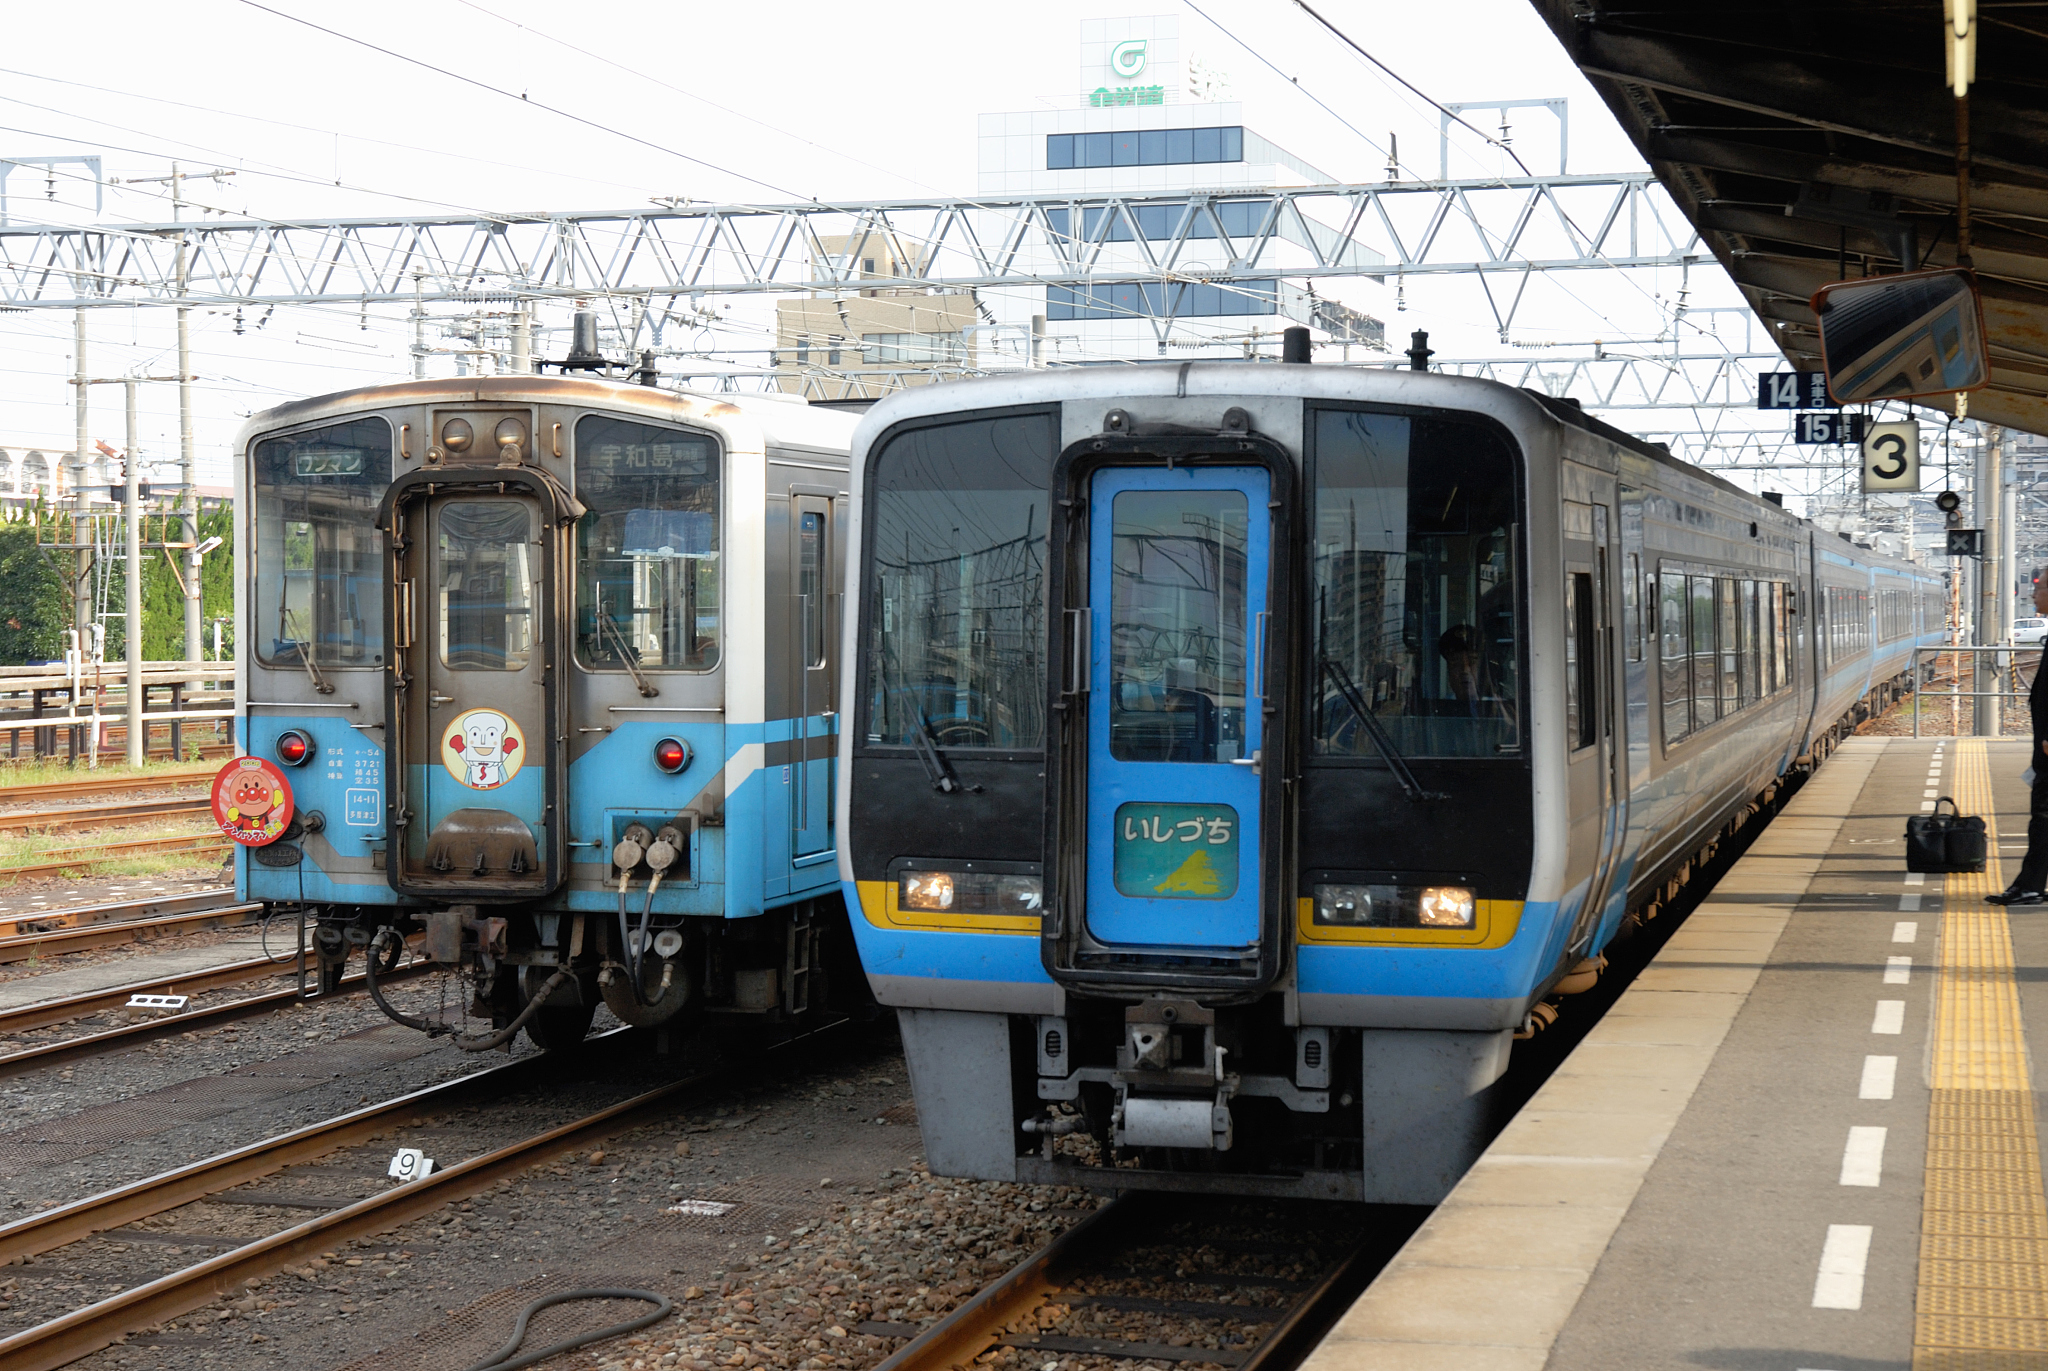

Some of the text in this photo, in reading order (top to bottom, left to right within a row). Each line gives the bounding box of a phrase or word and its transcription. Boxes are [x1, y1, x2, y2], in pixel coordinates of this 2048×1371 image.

[1768, 374, 1800, 408] 14
[1810, 373, 1826, 408] 乗車口
[1802, 415, 1831, 442] 15
[298, 454, 361, 472] ワンマン
[600, 444, 673, 469] 宇和島
[1871, 433, 1908, 480] 3
[1124, 815, 1232, 845] いしづち
[398, 1153, 415, 1176] 9
